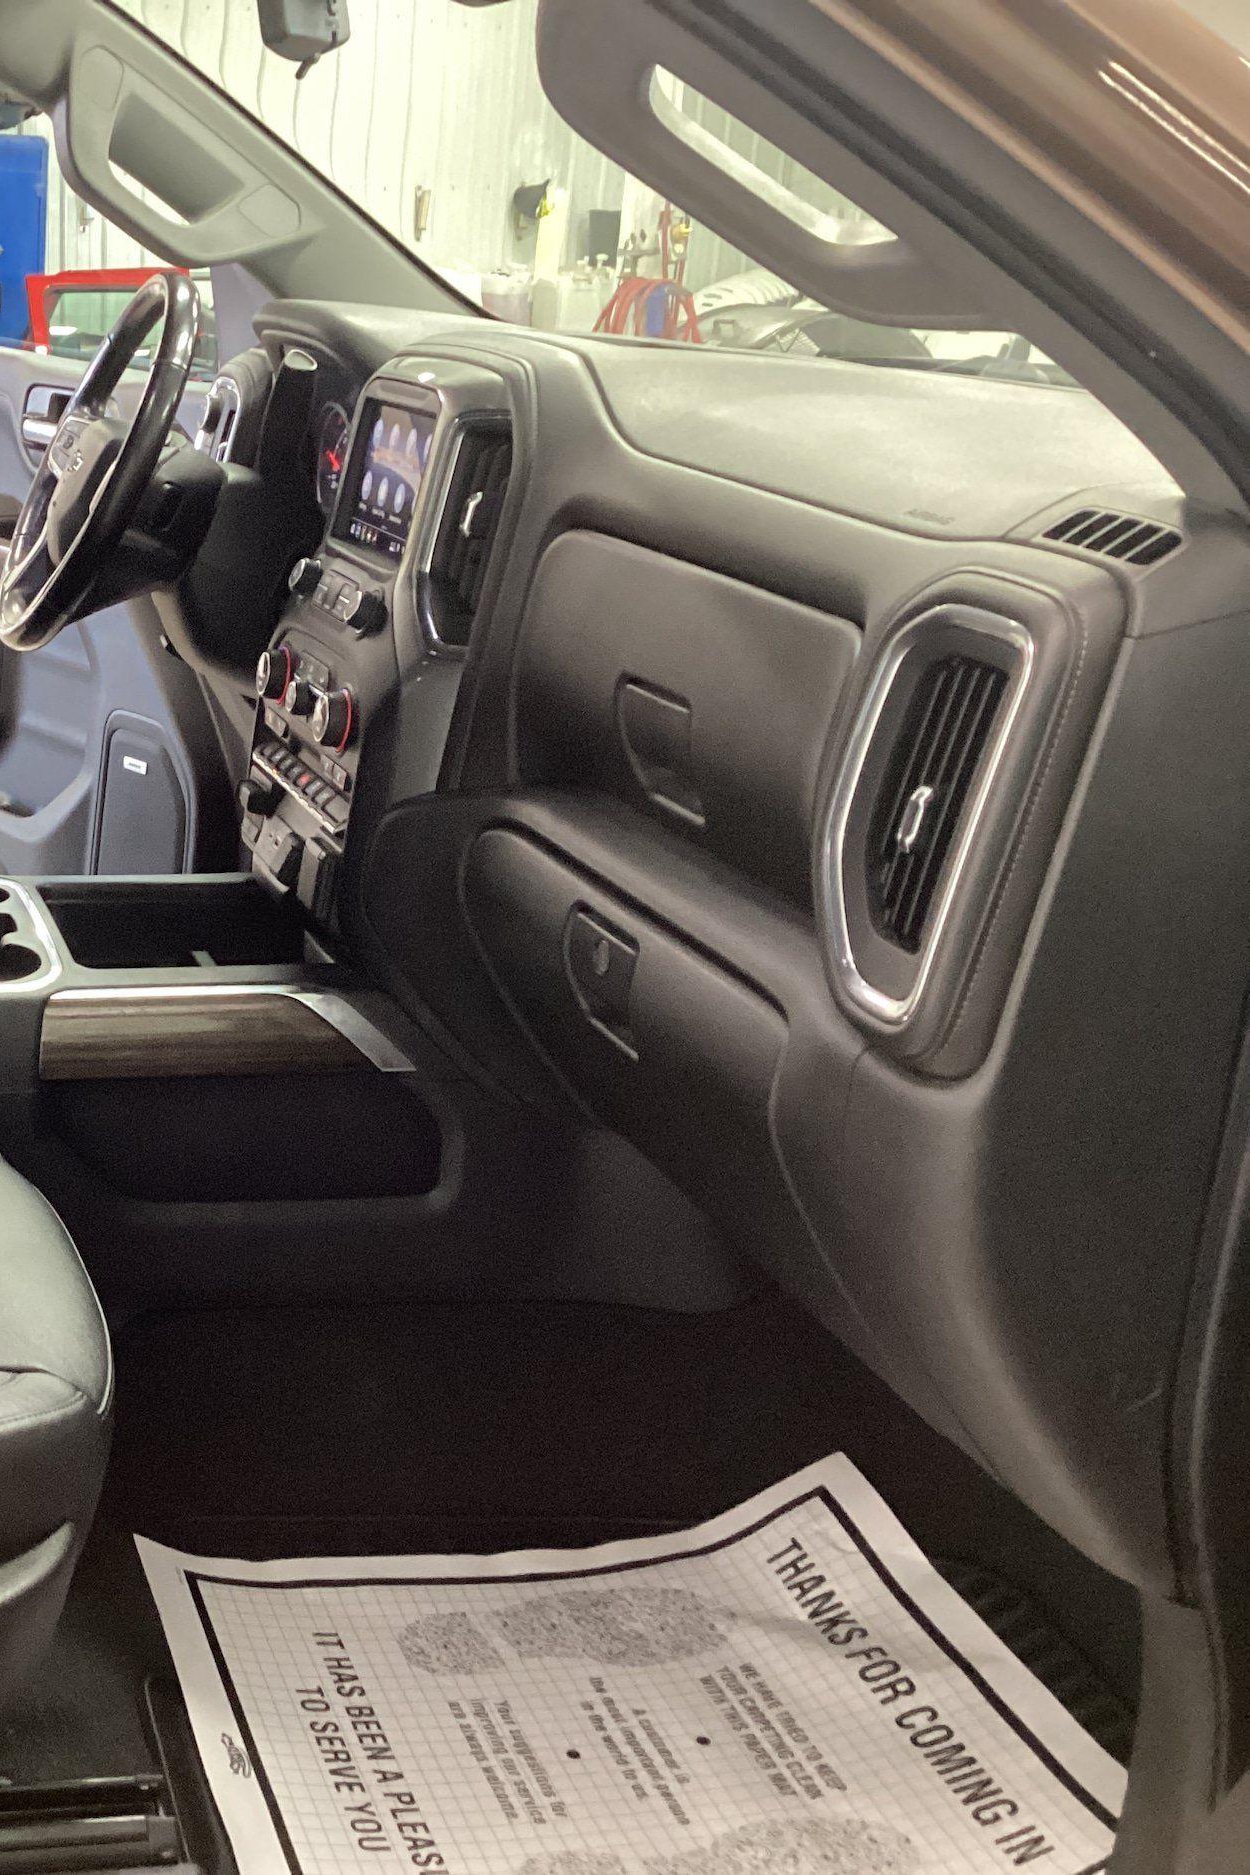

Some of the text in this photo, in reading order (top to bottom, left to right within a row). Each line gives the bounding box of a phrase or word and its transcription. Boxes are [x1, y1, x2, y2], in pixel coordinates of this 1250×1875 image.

[312, 1632, 345, 1649] IT
[323, 1657, 366, 1698] HAS
[767, 1537, 1055, 1866] THANKS FOR COMING IN
[345, 1706, 395, 1761] BEEN
[296, 1685, 391, 1852] TO SERVE YOU
[372, 1768, 404, 1783] A
